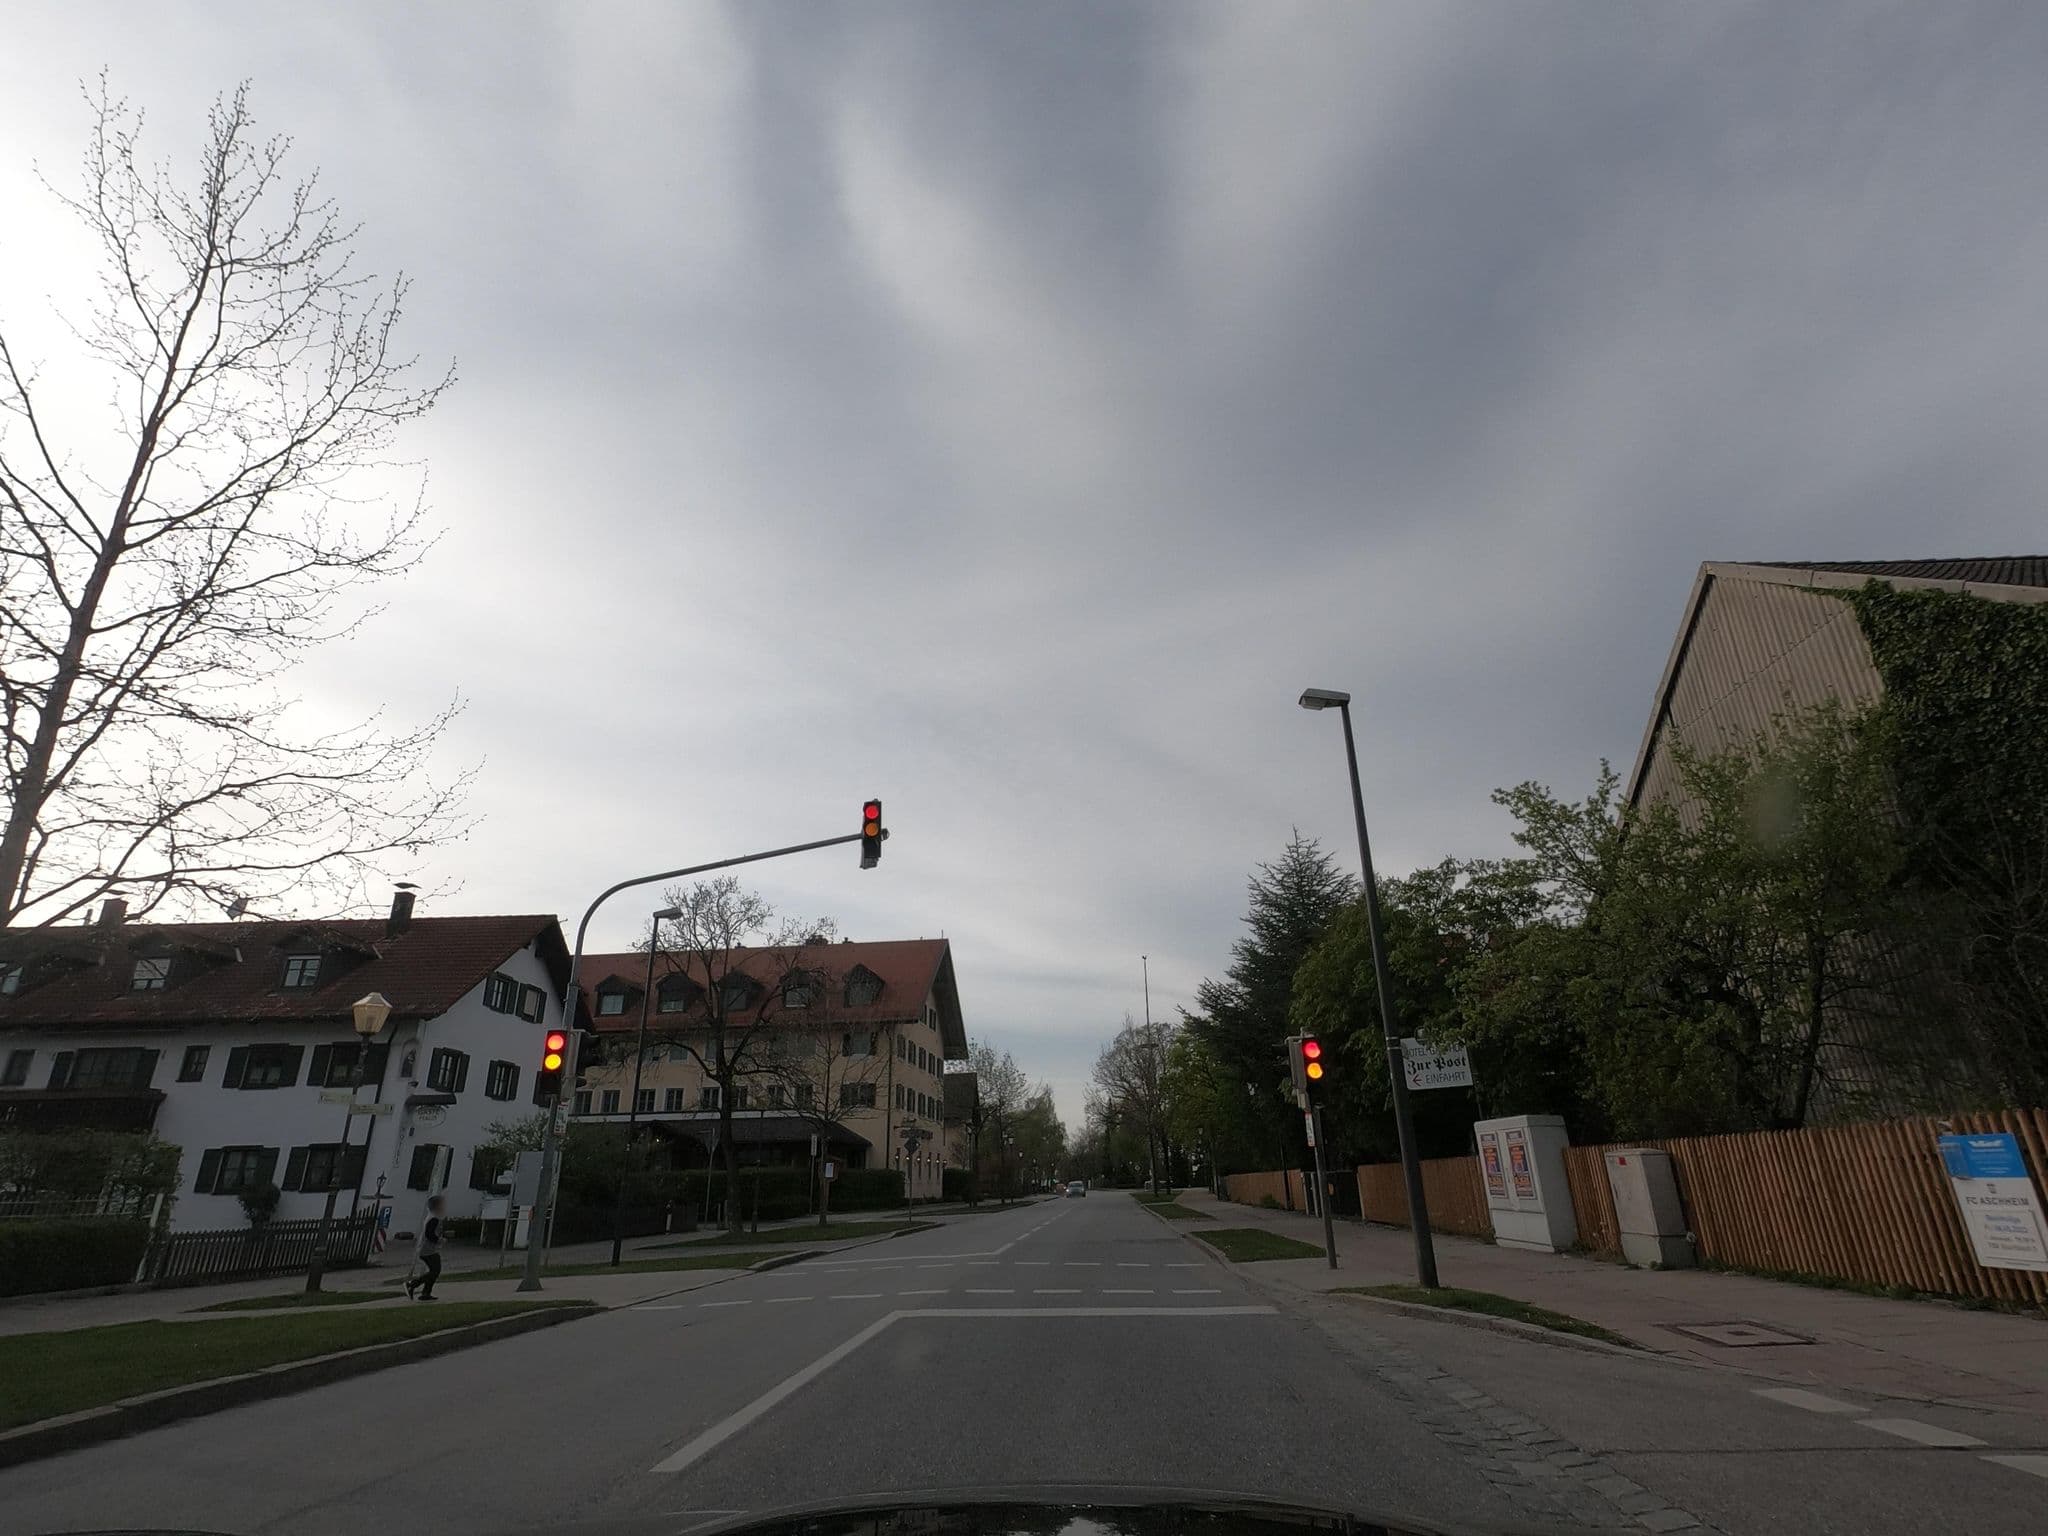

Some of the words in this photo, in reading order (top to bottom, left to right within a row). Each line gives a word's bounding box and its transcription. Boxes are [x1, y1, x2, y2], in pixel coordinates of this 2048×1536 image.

[1407, 1060, 1431, 1075] Zur
[1433, 1057, 1466, 1071] Post
[1425, 1071, 1466, 1083] EINFAHRT
